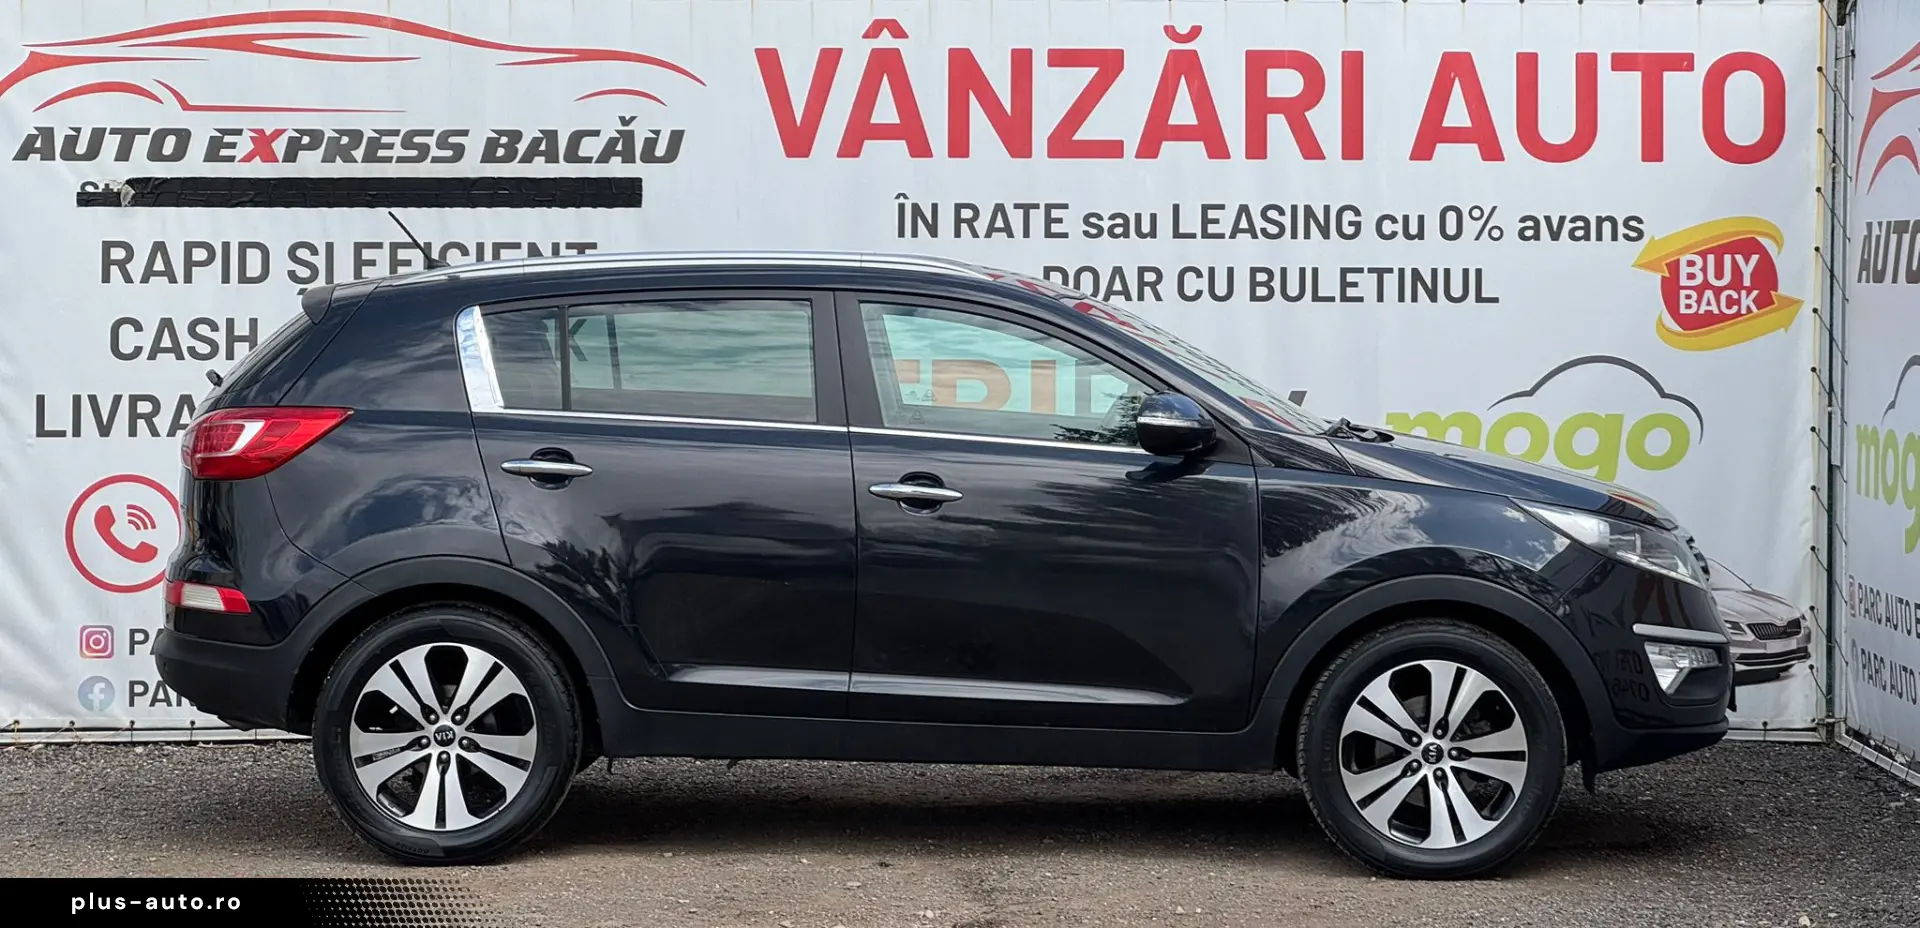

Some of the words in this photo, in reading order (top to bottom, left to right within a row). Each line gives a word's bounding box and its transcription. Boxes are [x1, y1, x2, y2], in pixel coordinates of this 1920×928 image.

[754, 18, 1364, 160] VÂNZĂRI
[1409, 51, 1786, 165] AUTO
[12, 127, 192, 162] AUTO
[203, 128, 470, 164] EXPRESS
[480, 116, 685, 164] BACĂU
[894, 192, 939, 239] ÎN
[953, 202, 1070, 239] RATE
[1082, 211, 1158, 240] sau
[1172, 203, 1363, 241] LEASING
[1374, 213, 1425, 242] cu
[1439, 205, 1504, 242] 0%
[1517, 213, 1645, 243] avans
[101, 240, 270, 284] RAPID
[1176, 265, 1235, 302] CU
[1249, 266, 1500, 303] BULETINUL
[1679, 253, 1760, 287] BUY
[1679, 289, 1760, 315] BACK
[110, 316, 258, 361] CASH
[35, 393, 196, 438] LIVRA
[1385, 411, 1691, 483] mogo
[1857, 582, 1882, 625] PARC
[1885, 592, 1912, 637] AUTO
[1861, 648, 1887, 692] PARC
[1890, 660, 1917, 706] AUTO
[434, 730, 454, 741] KIA
[1428, 744, 1437, 763] KIA
